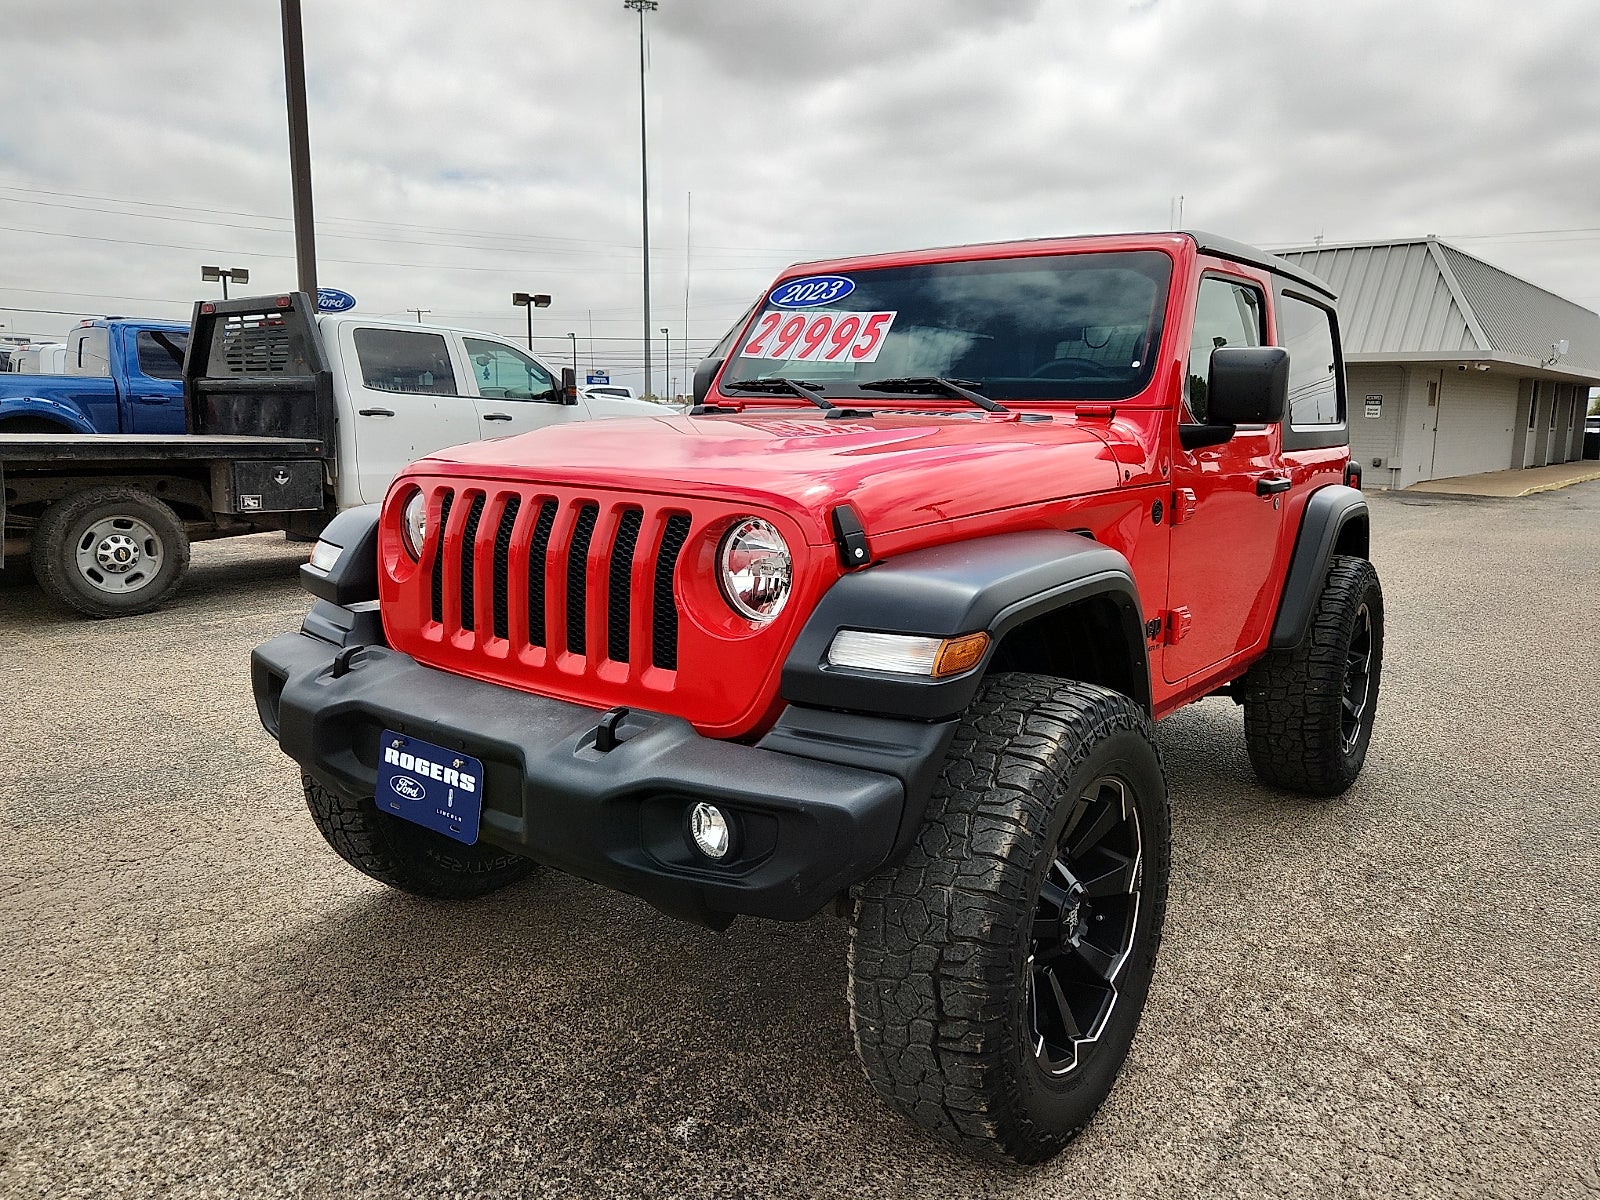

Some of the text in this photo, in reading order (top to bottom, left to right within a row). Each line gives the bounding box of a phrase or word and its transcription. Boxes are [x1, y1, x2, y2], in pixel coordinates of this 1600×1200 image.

[778, 280, 844, 304] 2023
[744, 312, 892, 360] 29995
[384, 746, 476, 793] ROGERS
[395, 777, 420, 798] Ford
[436, 808, 462, 823] LINCOLN
